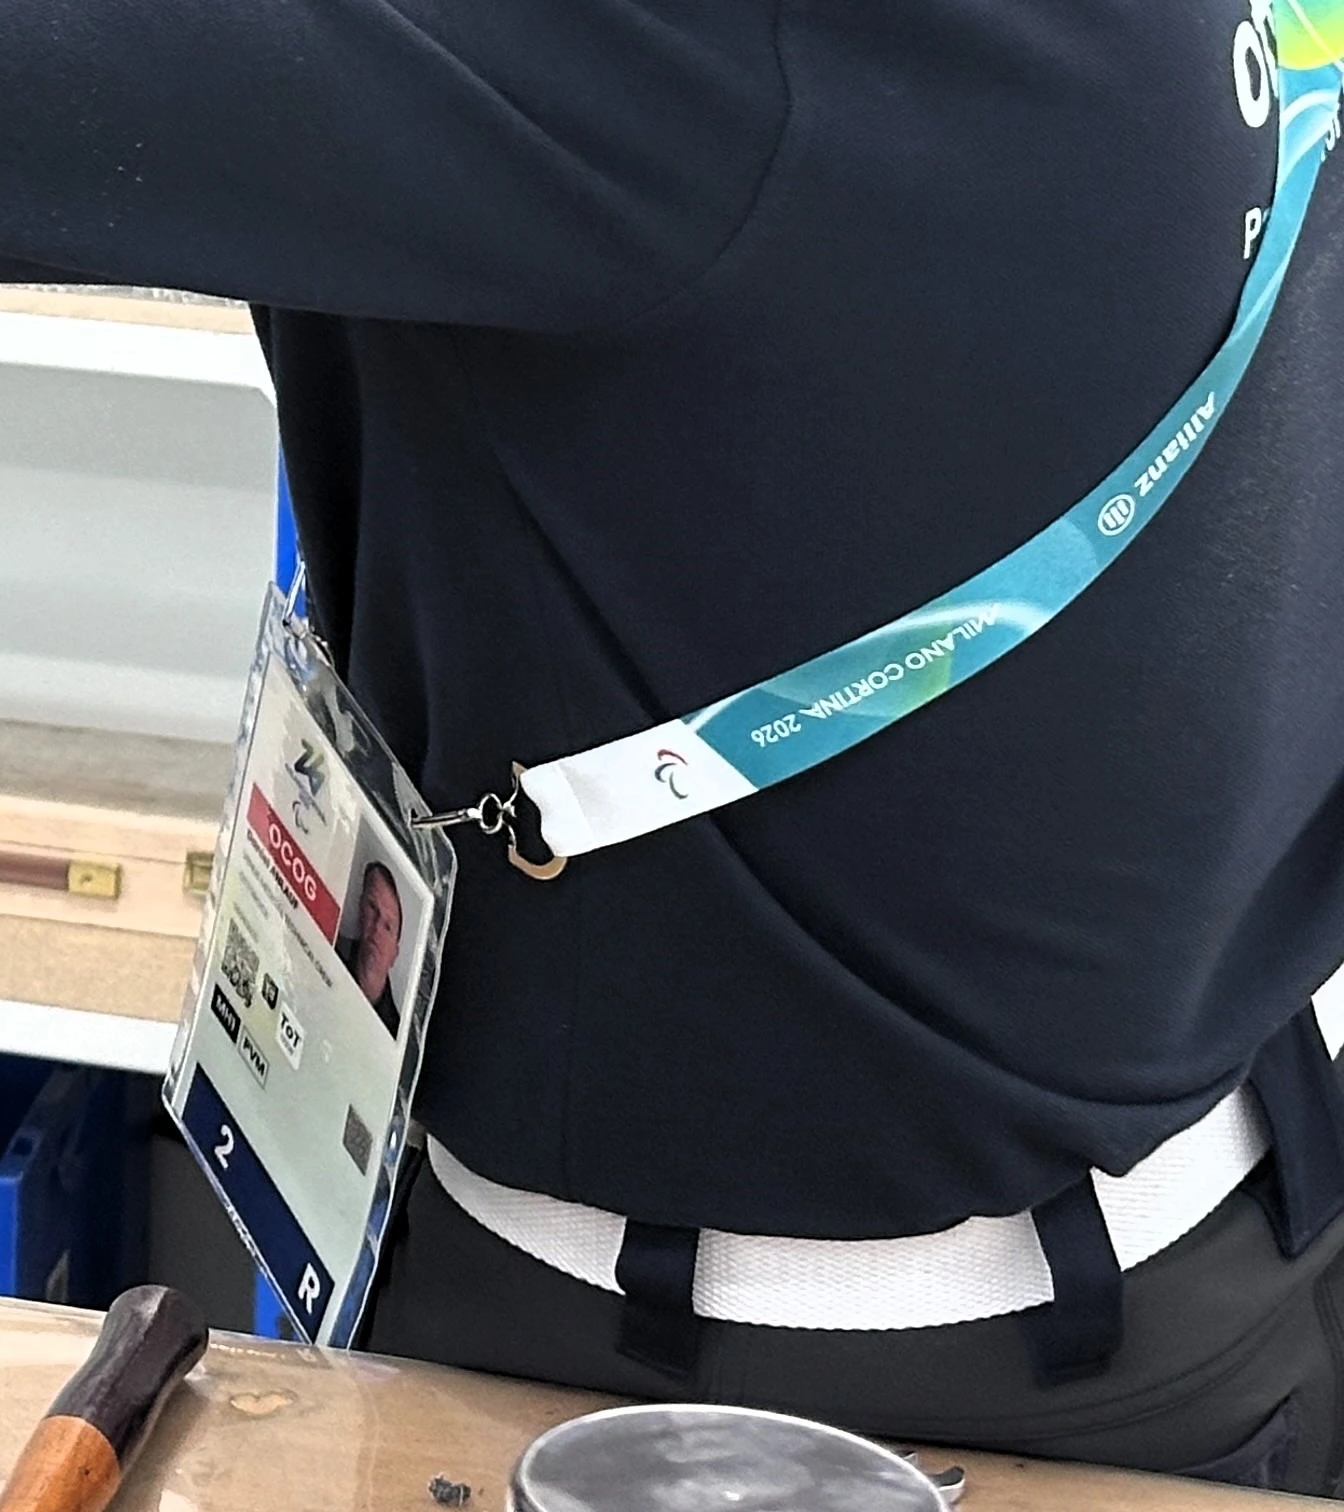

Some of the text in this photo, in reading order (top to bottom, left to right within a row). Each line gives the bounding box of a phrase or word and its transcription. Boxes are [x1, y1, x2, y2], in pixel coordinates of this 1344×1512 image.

[1134, 391, 1215, 497] Allianz
[750, 602, 1000, 748] MILANO CORTINA 2026
[269, 823, 317, 901] OCOG
[280, 1013, 303, 1049] ToT
[214, 1124, 235, 1170] 2
[297, 1262, 321, 1315] R
